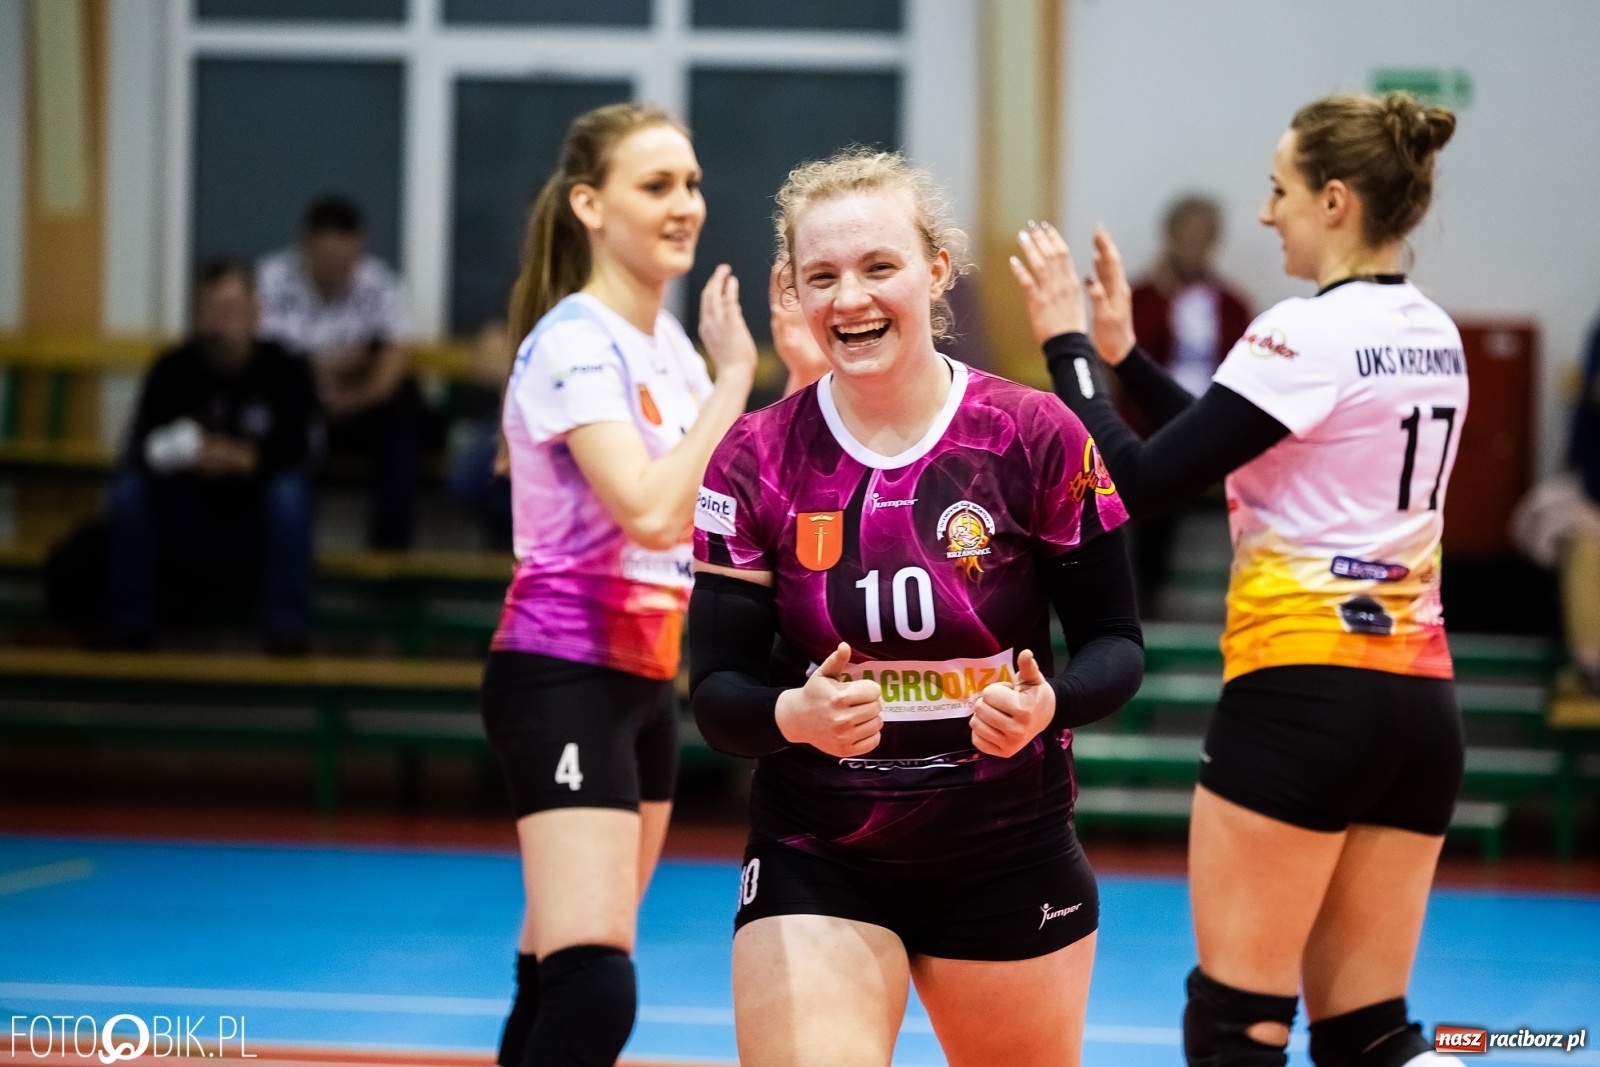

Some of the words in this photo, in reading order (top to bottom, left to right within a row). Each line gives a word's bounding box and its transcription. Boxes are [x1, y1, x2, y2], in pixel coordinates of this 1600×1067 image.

[1356, 347, 1396, 377] UKS
[1397, 406, 1456, 511] 17
[697, 492, 730, 516] oint
[855, 566, 936, 643] 10
[881, 705, 916, 713] TRZENIE
[554, 742, 584, 791] 4
